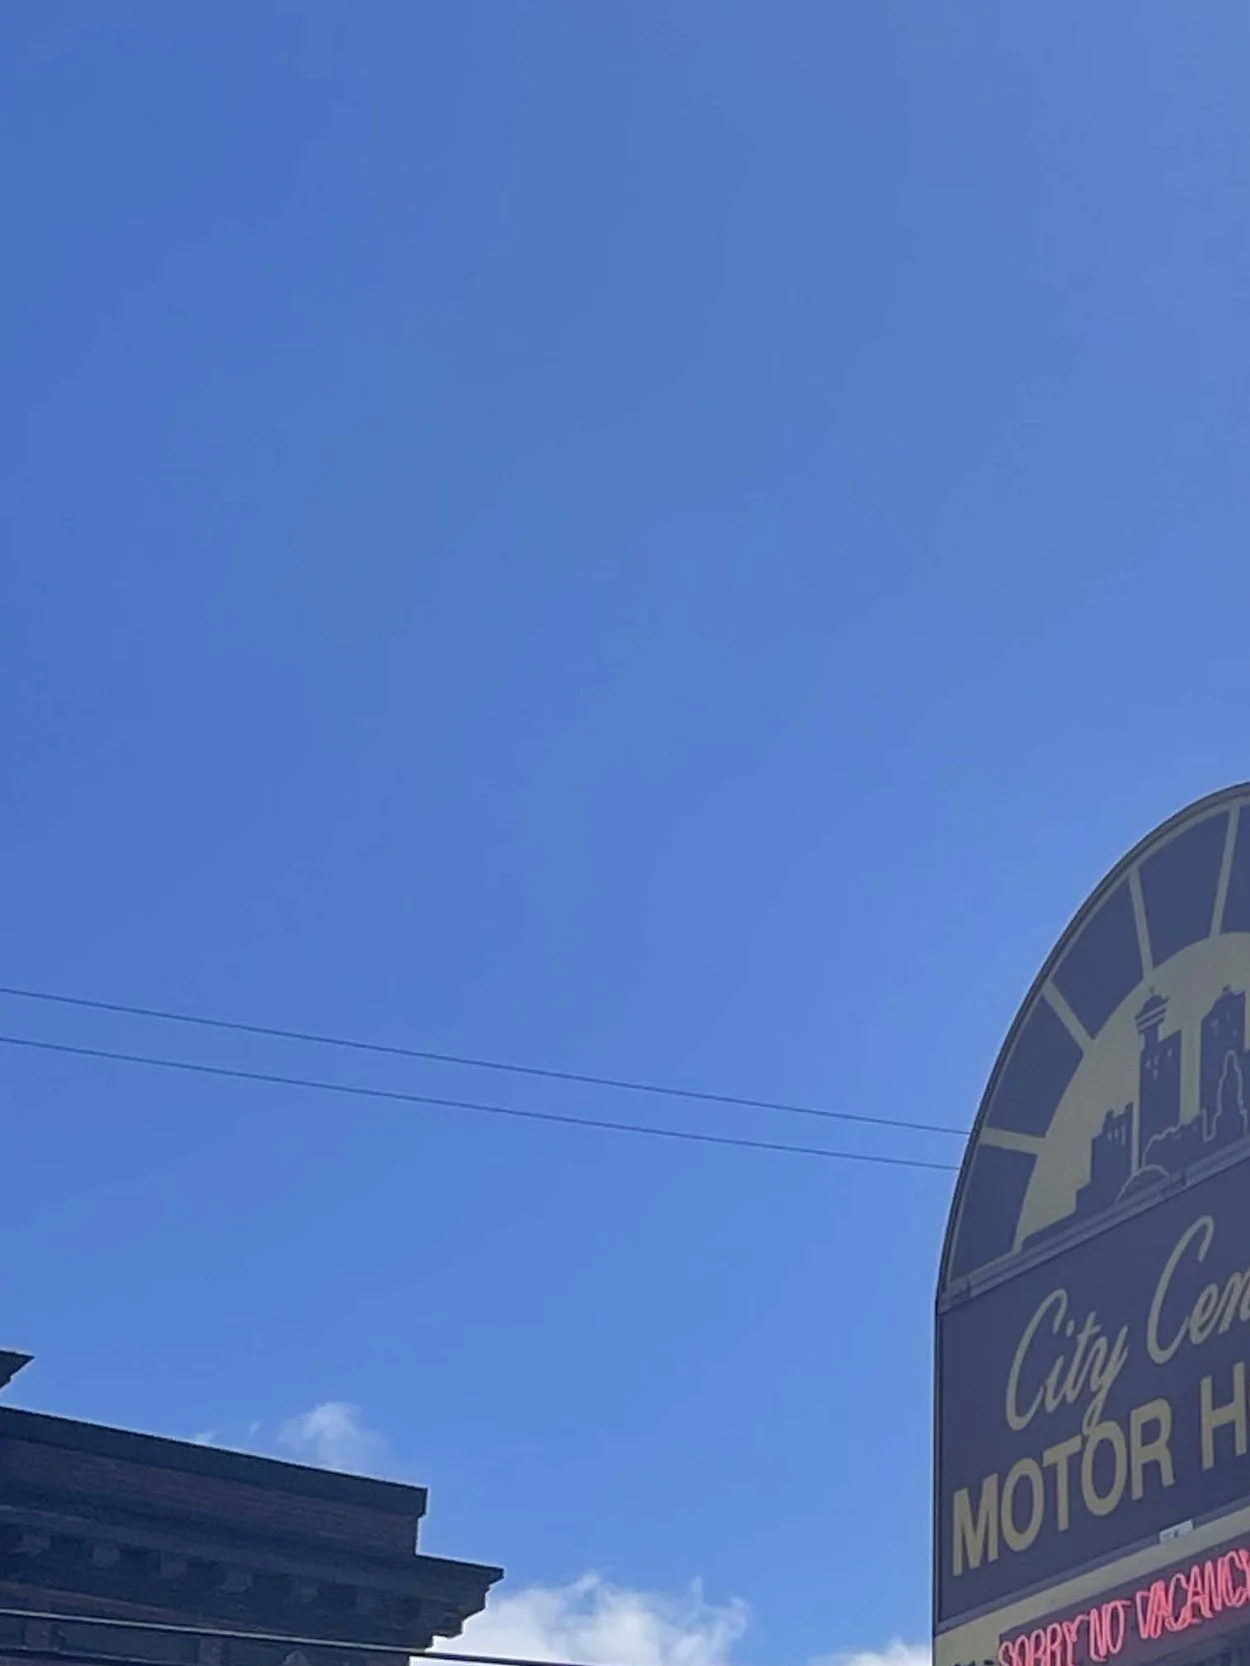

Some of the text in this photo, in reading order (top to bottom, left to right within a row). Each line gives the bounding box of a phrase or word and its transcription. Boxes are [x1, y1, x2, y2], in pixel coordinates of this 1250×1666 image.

[1006, 1288, 1128, 1440] City
[952, 1397, 1175, 1576] MOTOR
[1088, 1600, 1132, 1663] NO
